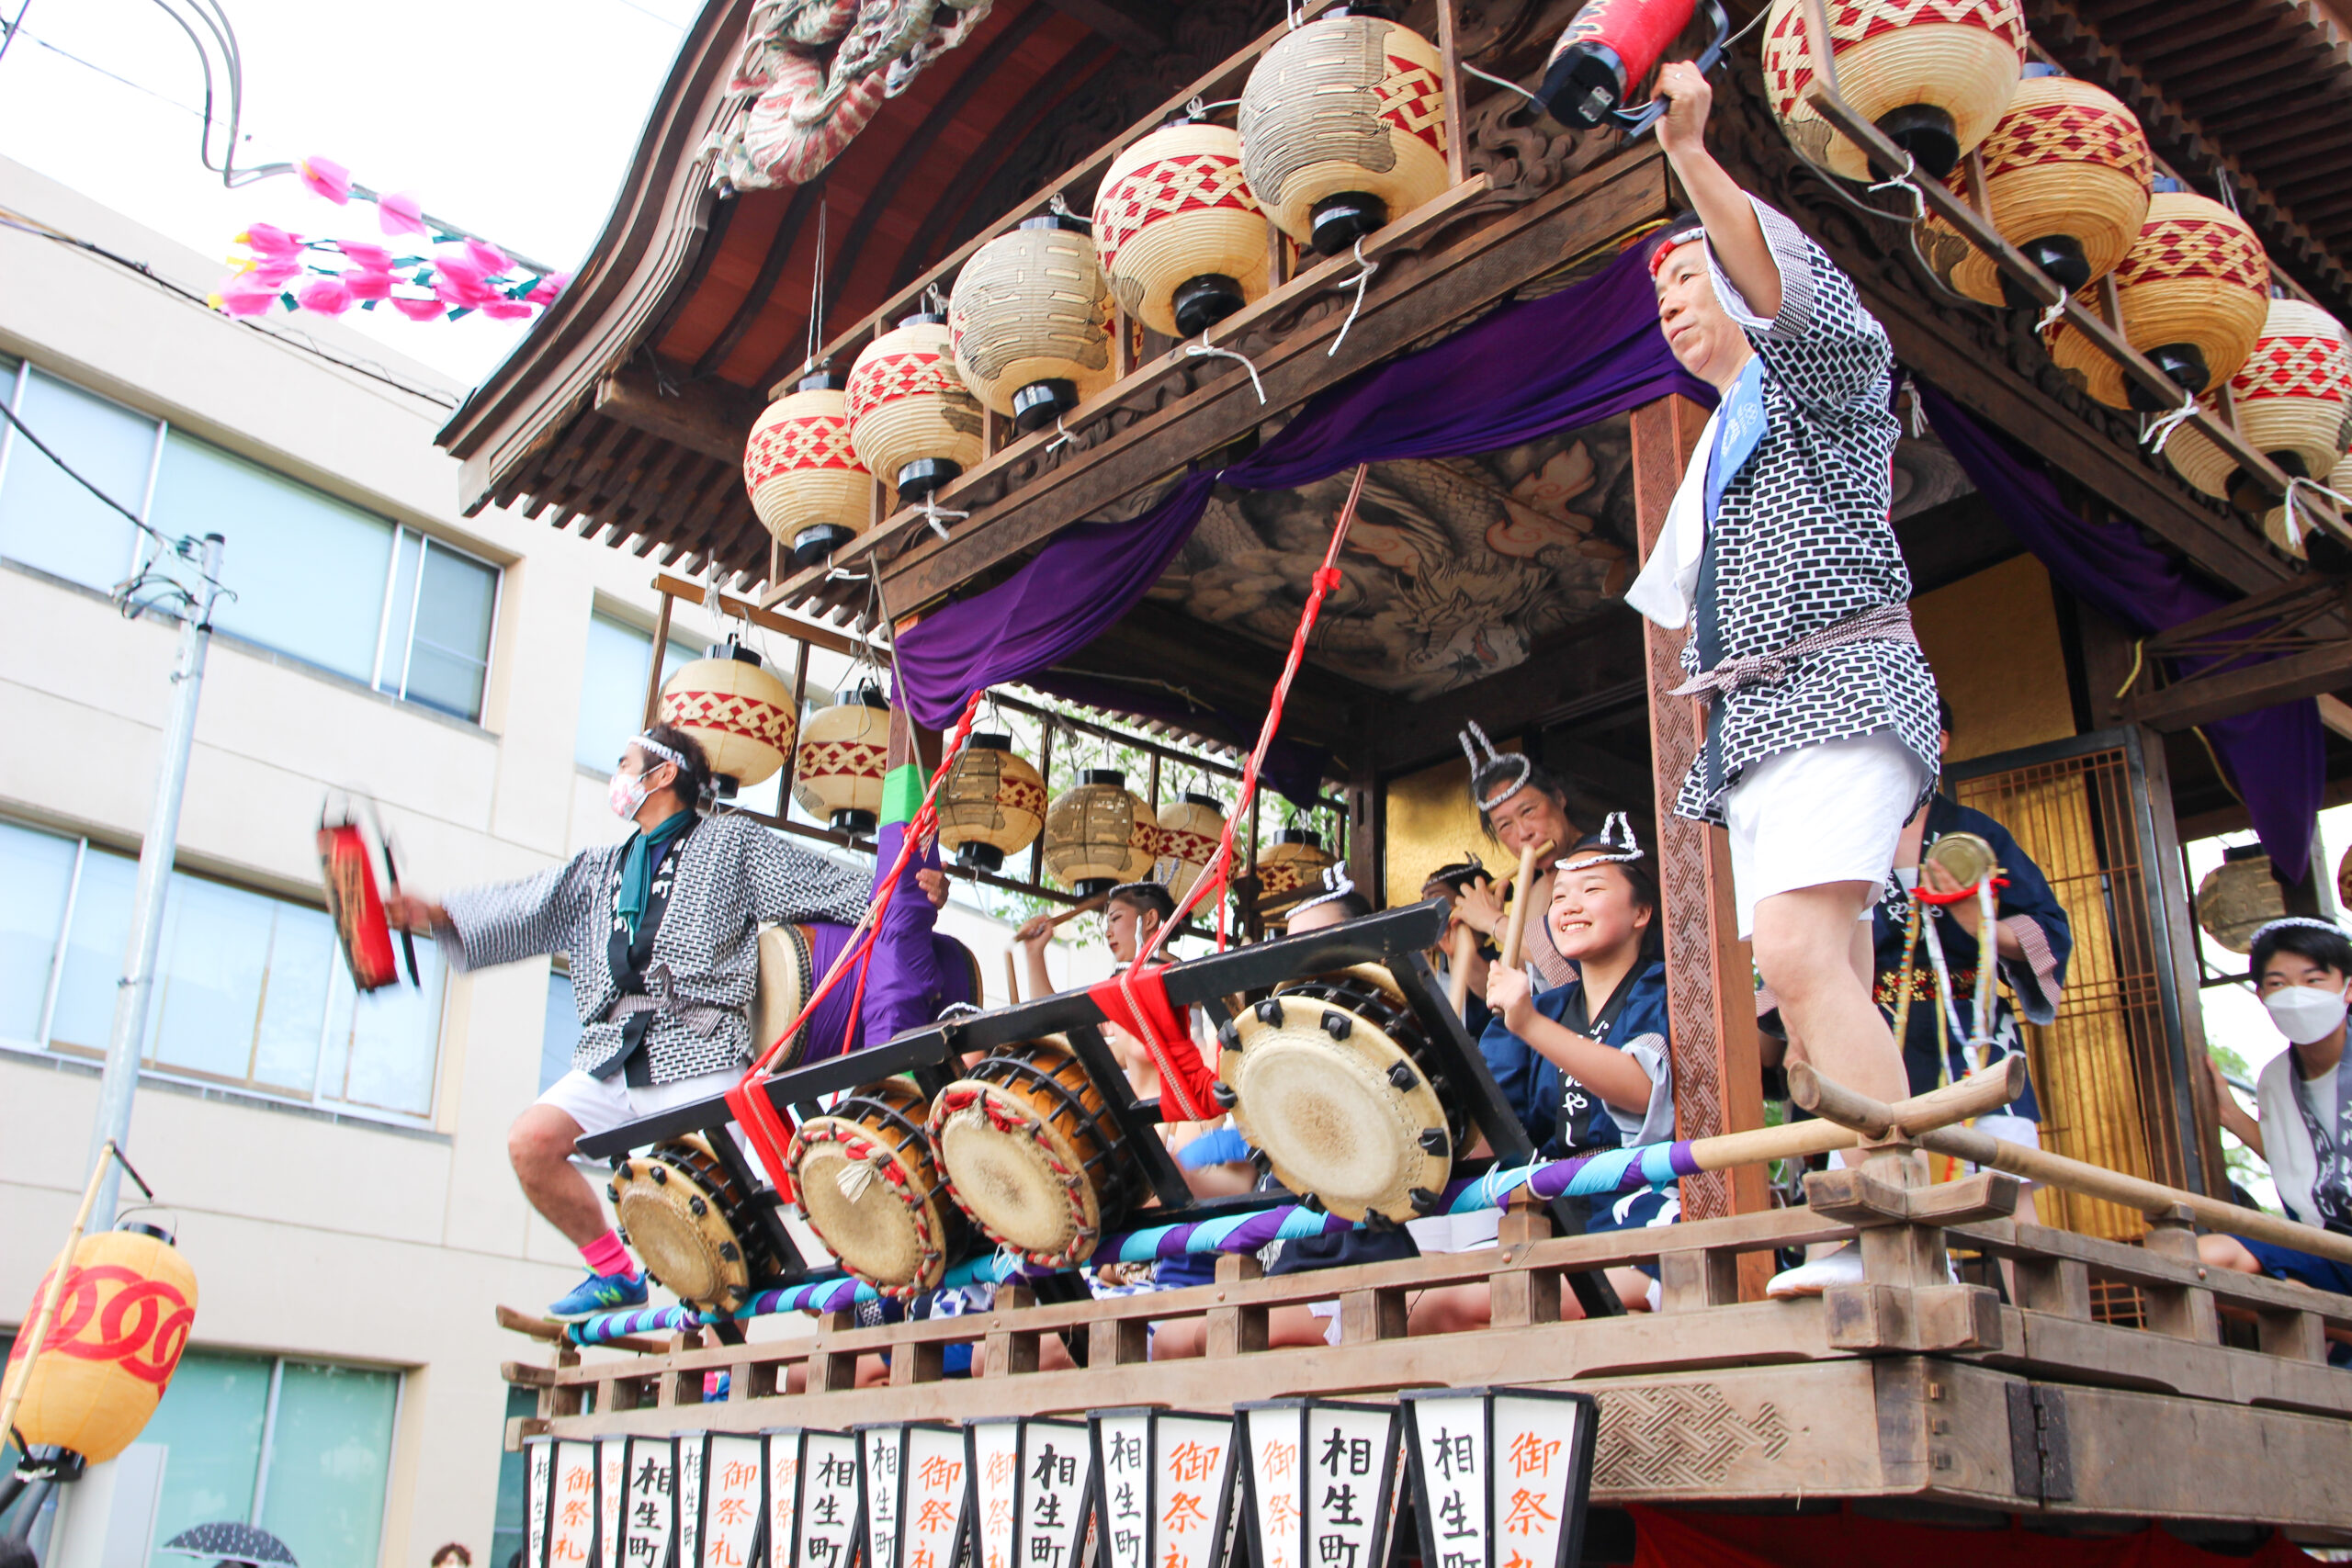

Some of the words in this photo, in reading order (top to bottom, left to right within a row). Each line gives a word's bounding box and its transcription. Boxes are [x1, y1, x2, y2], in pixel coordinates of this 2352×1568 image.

[553, 1465, 595, 1561] 御祭礼
[604, 1460, 626, 1556] 御祭礼
[629, 1457, 673, 1568] 相生町
[707, 1460, 757, 1565] 御祭礼
[775, 1457, 798, 1568] 御祭礼
[808, 1452, 856, 1568] 相生町
[872, 1437, 897, 1568] 相生町
[1032, 1443, 1076, 1568] 相生町
[1109, 1430, 1141, 1568] 相生町
[1320, 1427, 1371, 1568] 相生町
